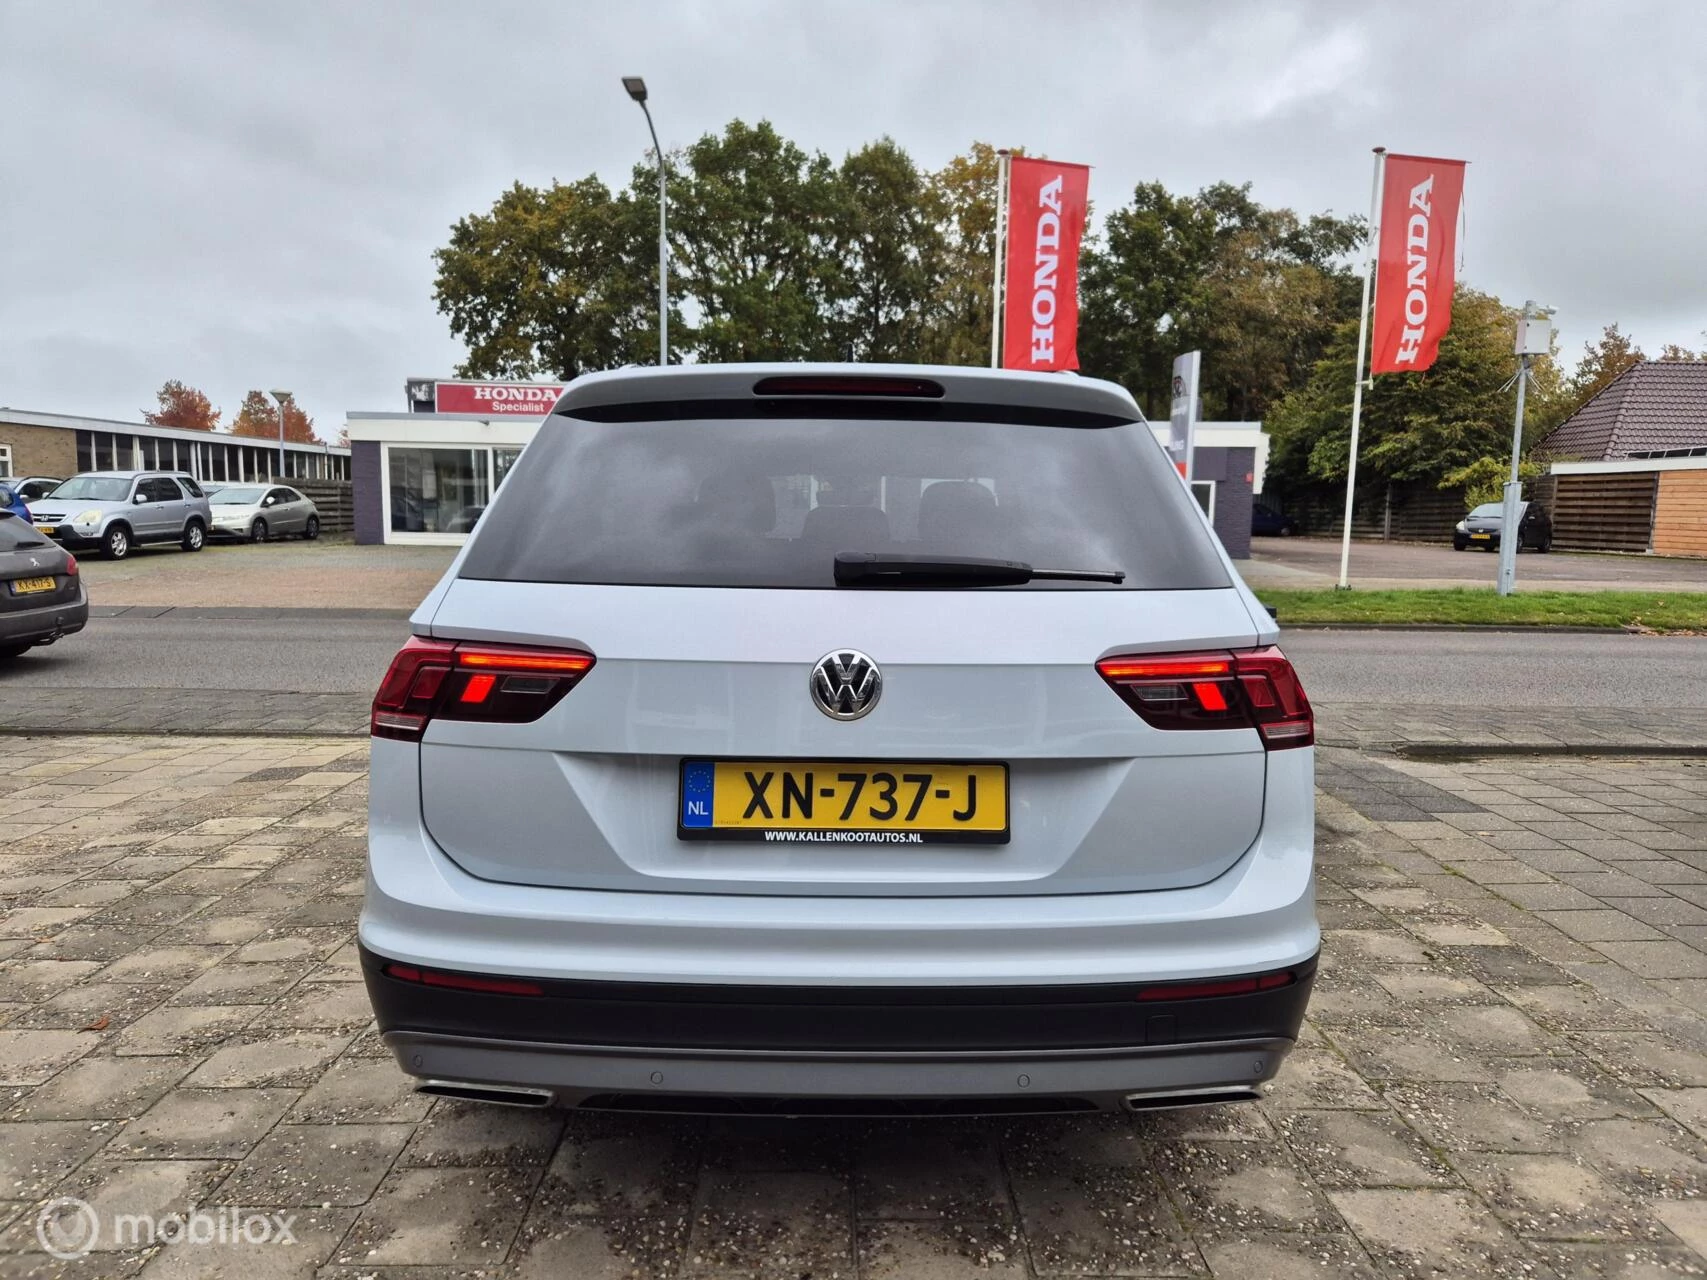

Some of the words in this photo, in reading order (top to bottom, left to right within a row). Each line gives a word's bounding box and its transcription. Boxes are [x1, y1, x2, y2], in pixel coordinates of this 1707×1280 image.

[1031, 174, 1064, 365] HONDA
[1395, 173, 1435, 365] HONDA
[474, 386, 558, 402] HONDA
[492, 401, 545, 413] Specialist
[742, 771, 978, 822] XN-737-J
[688, 801, 709, 816] NL
[765, 830, 924, 844] WWW.KALLENKOOTAUTOS.NL
